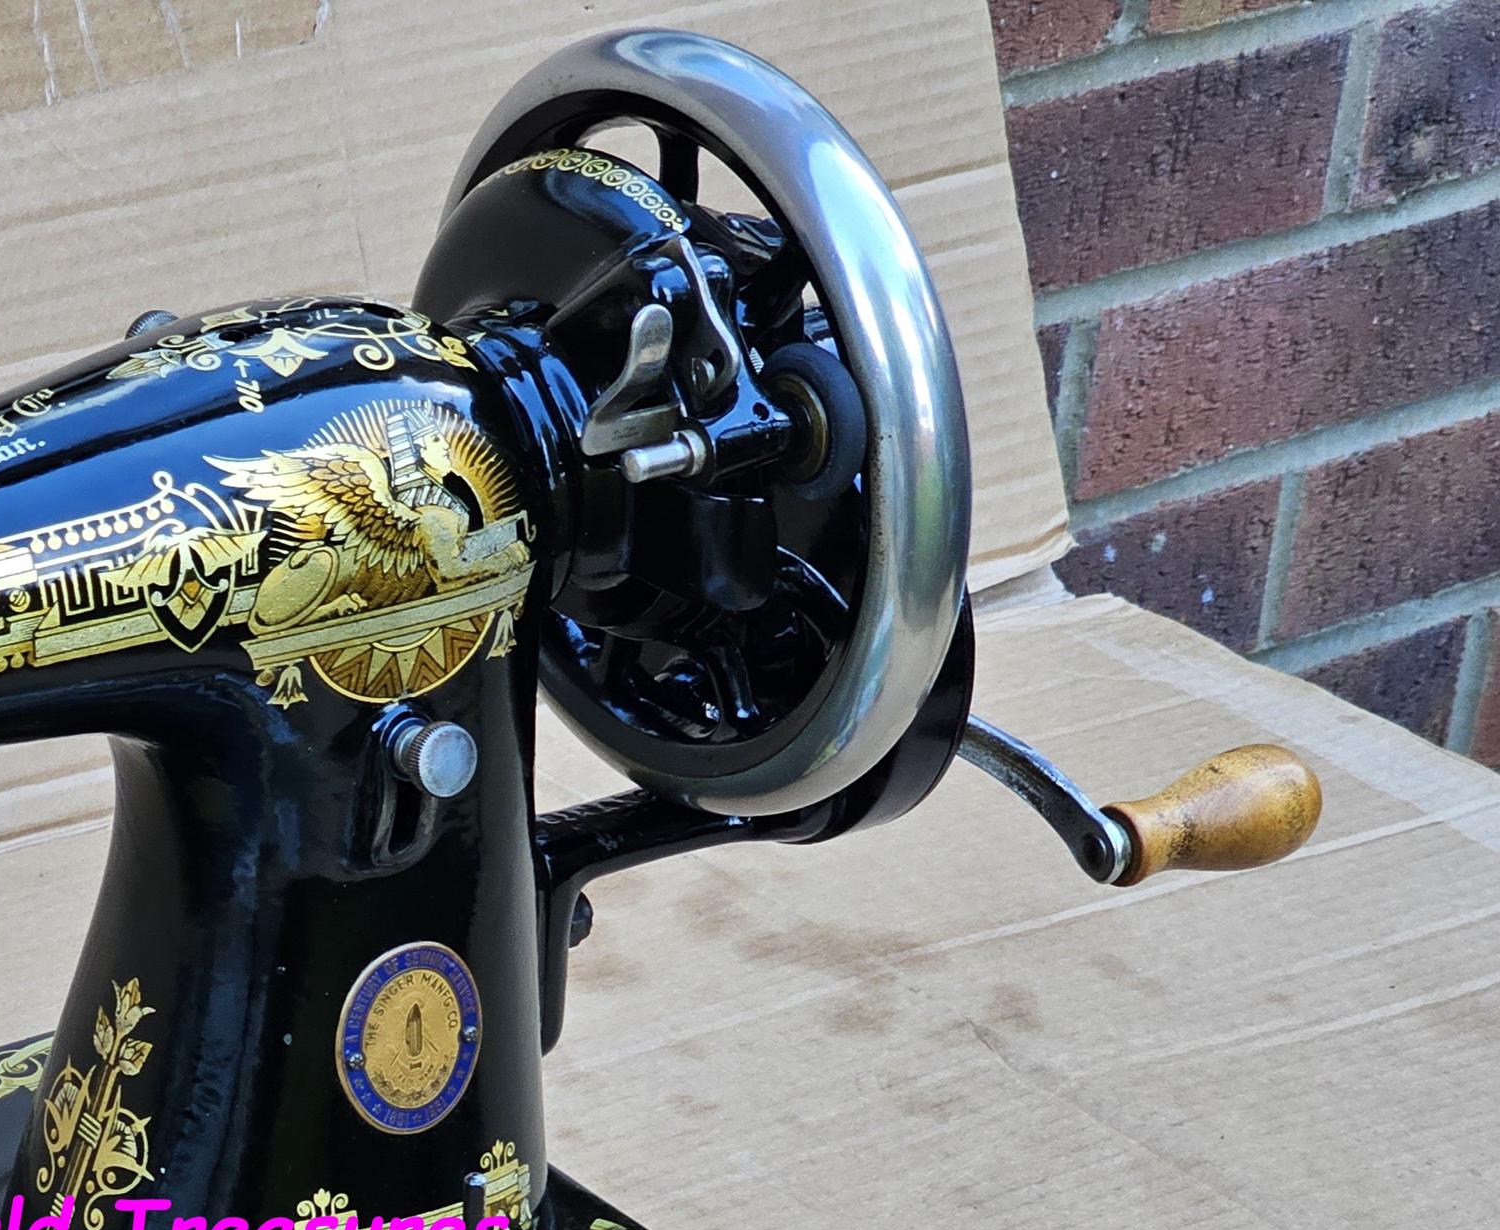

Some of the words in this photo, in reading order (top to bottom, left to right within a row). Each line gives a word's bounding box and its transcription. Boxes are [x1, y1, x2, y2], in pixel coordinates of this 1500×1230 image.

[348, 972, 382, 1028] CENTURY
[365, 1022, 379, 1049] THE
[373, 974, 415, 1017] SINGER
